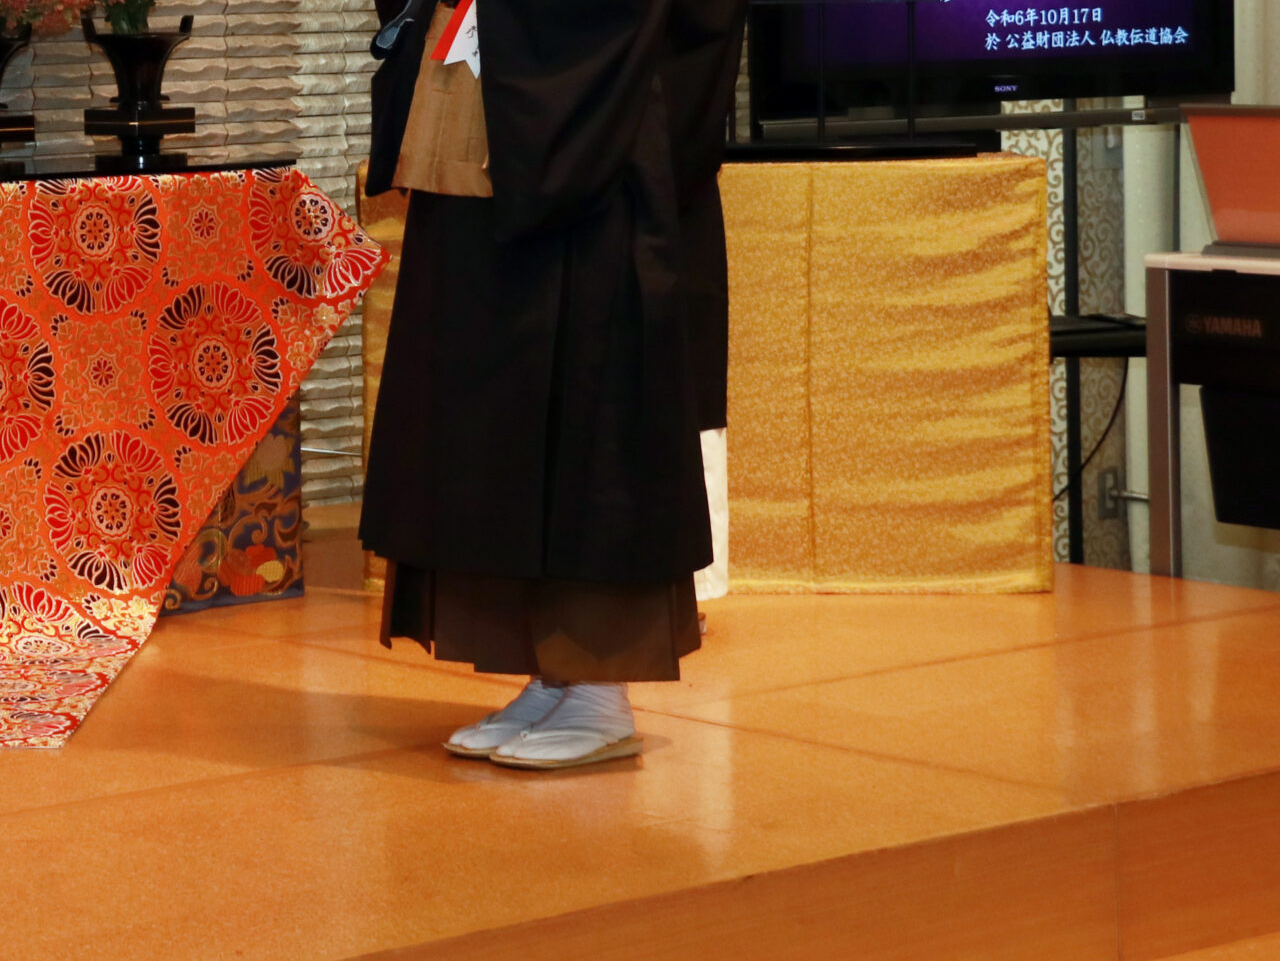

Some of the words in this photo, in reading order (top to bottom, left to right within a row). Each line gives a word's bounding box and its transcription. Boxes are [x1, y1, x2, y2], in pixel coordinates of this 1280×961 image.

[985, 7, 1103, 27] 令和6年10月17日
[1006, 30, 1096, 50] 公益財団法人
[1099, 26, 1189, 46] 仏教伝道協会
[994, 85, 1018, 93] SONY
[1203, 315, 1263, 337] YAMAHA
